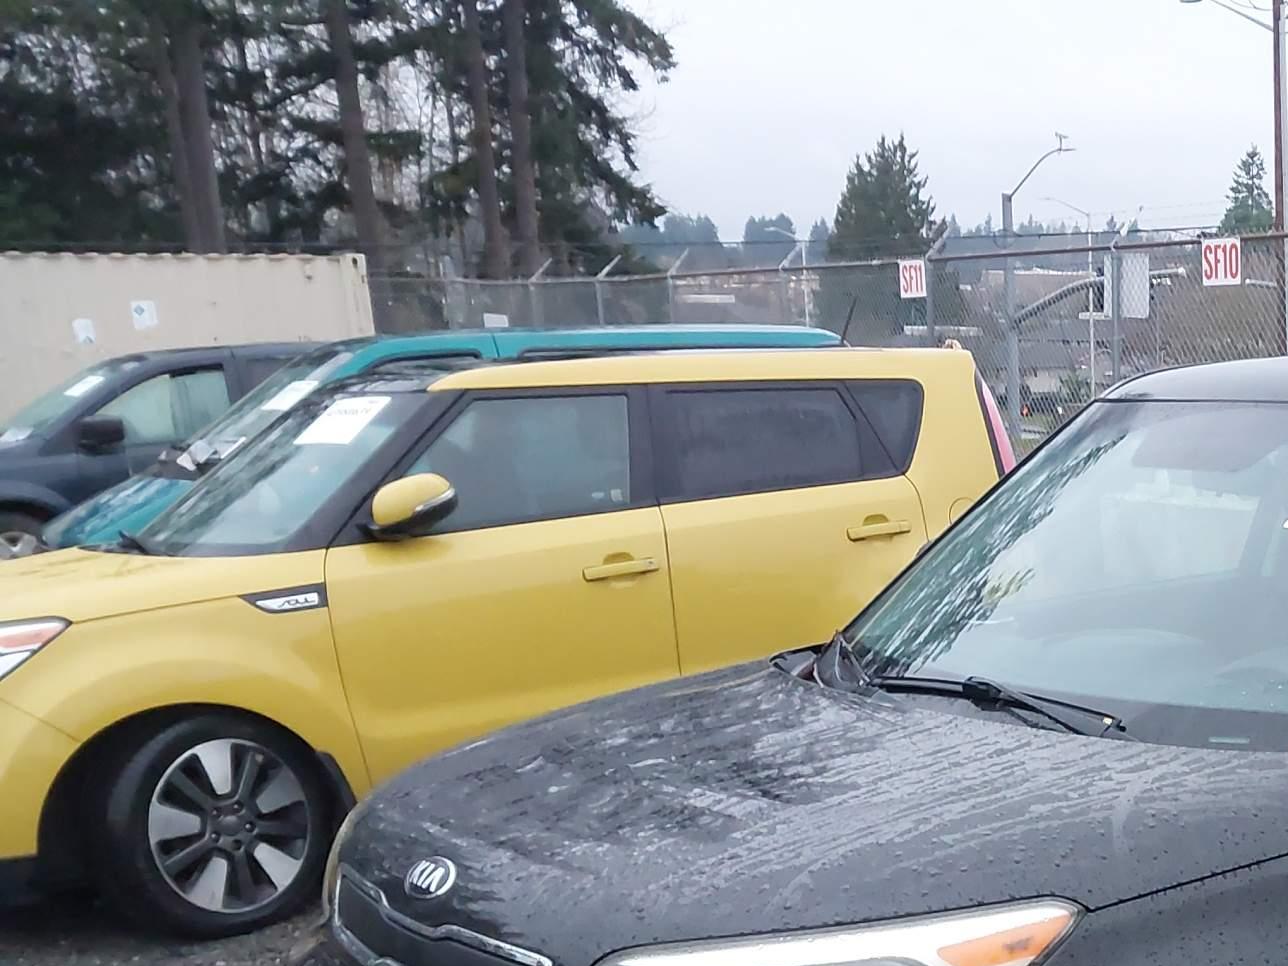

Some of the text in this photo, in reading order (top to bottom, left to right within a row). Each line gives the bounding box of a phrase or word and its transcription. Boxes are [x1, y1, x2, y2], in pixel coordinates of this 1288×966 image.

[1203, 242, 1239, 280] SF10
[902, 263, 924, 294] SF11
[409, 859, 446, 893] KIA
